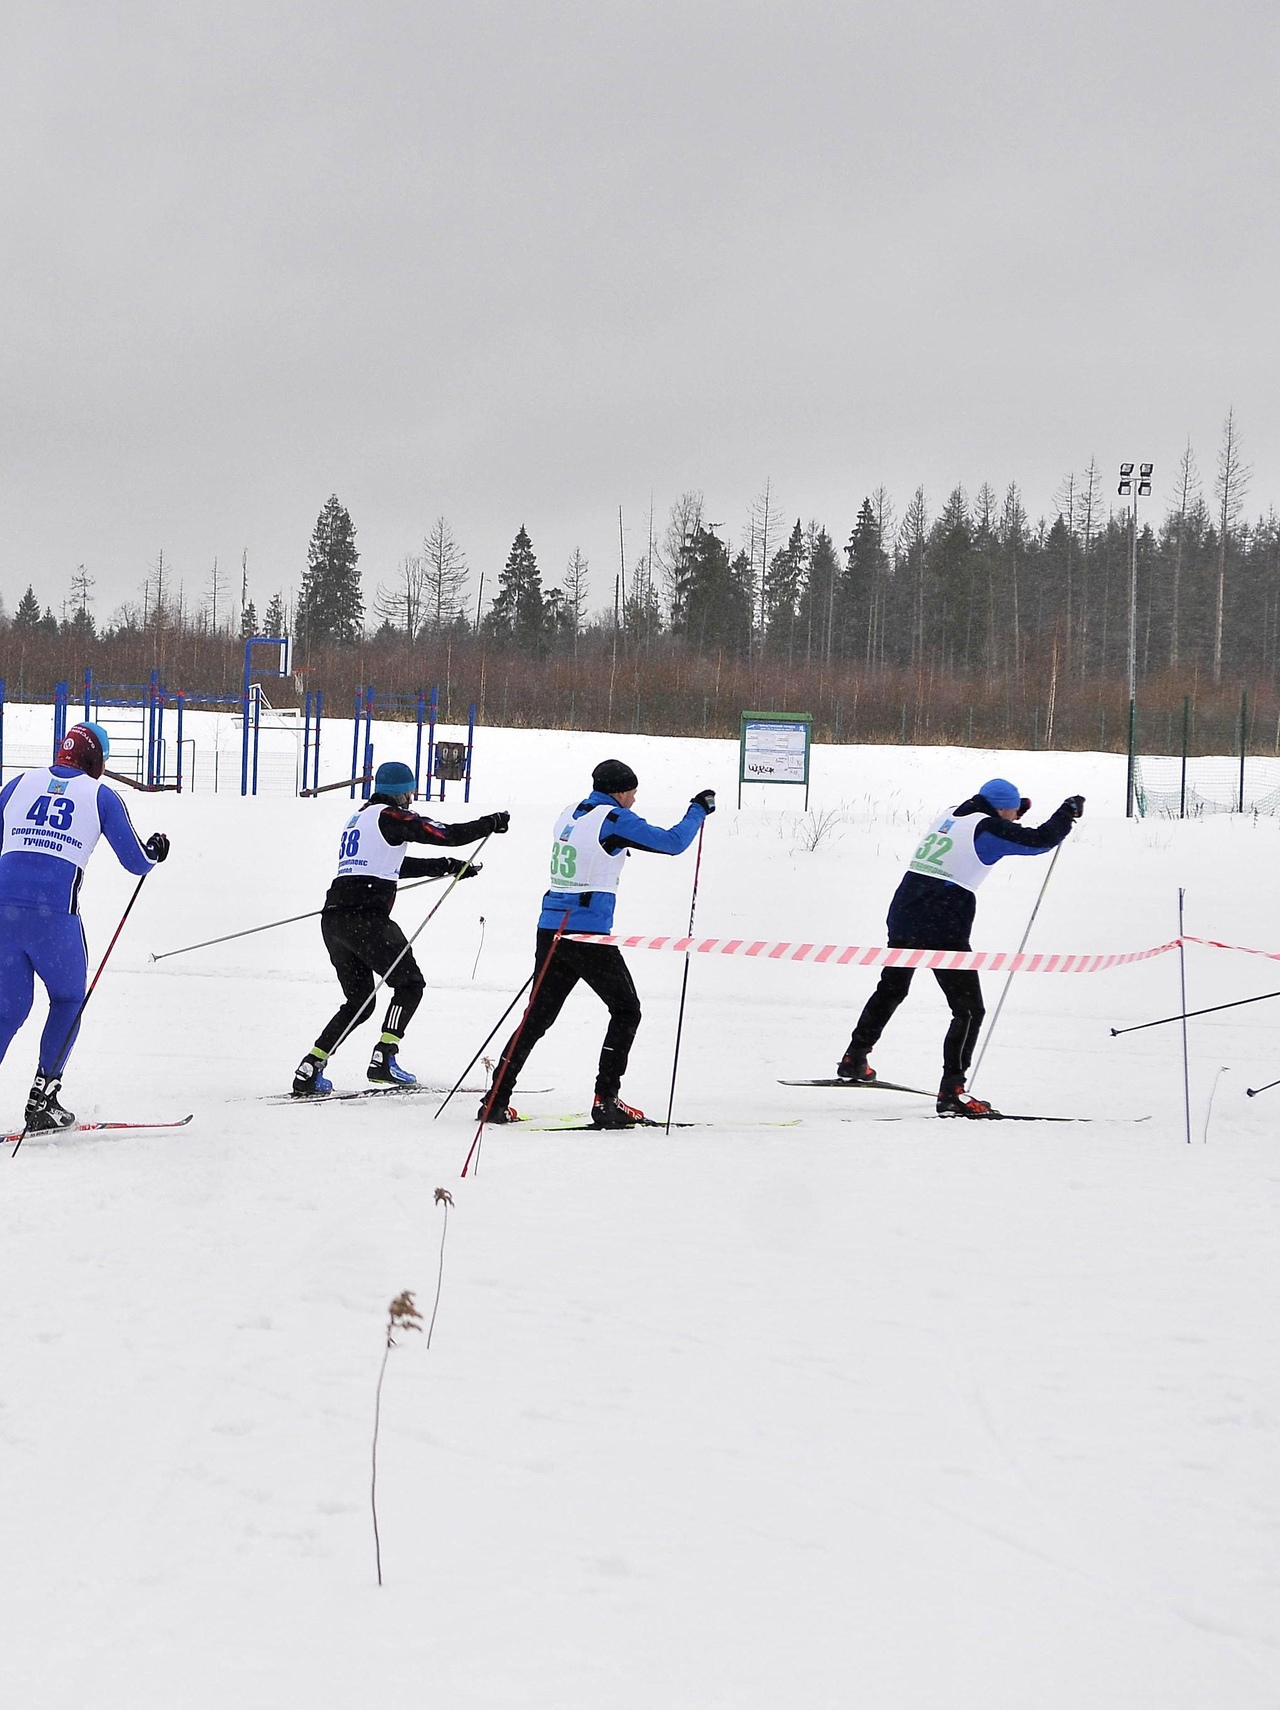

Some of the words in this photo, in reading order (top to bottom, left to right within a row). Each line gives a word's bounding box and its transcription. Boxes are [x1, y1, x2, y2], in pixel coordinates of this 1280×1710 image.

[26, 795, 75, 831] 43
[11, 827, 83, 849] Спорткомплекс
[23, 837, 63, 852] ТУЧКОВО
[339, 829, 361, 860] 38
[915, 833, 954, 866] 32
[550, 842, 577, 879] 33
